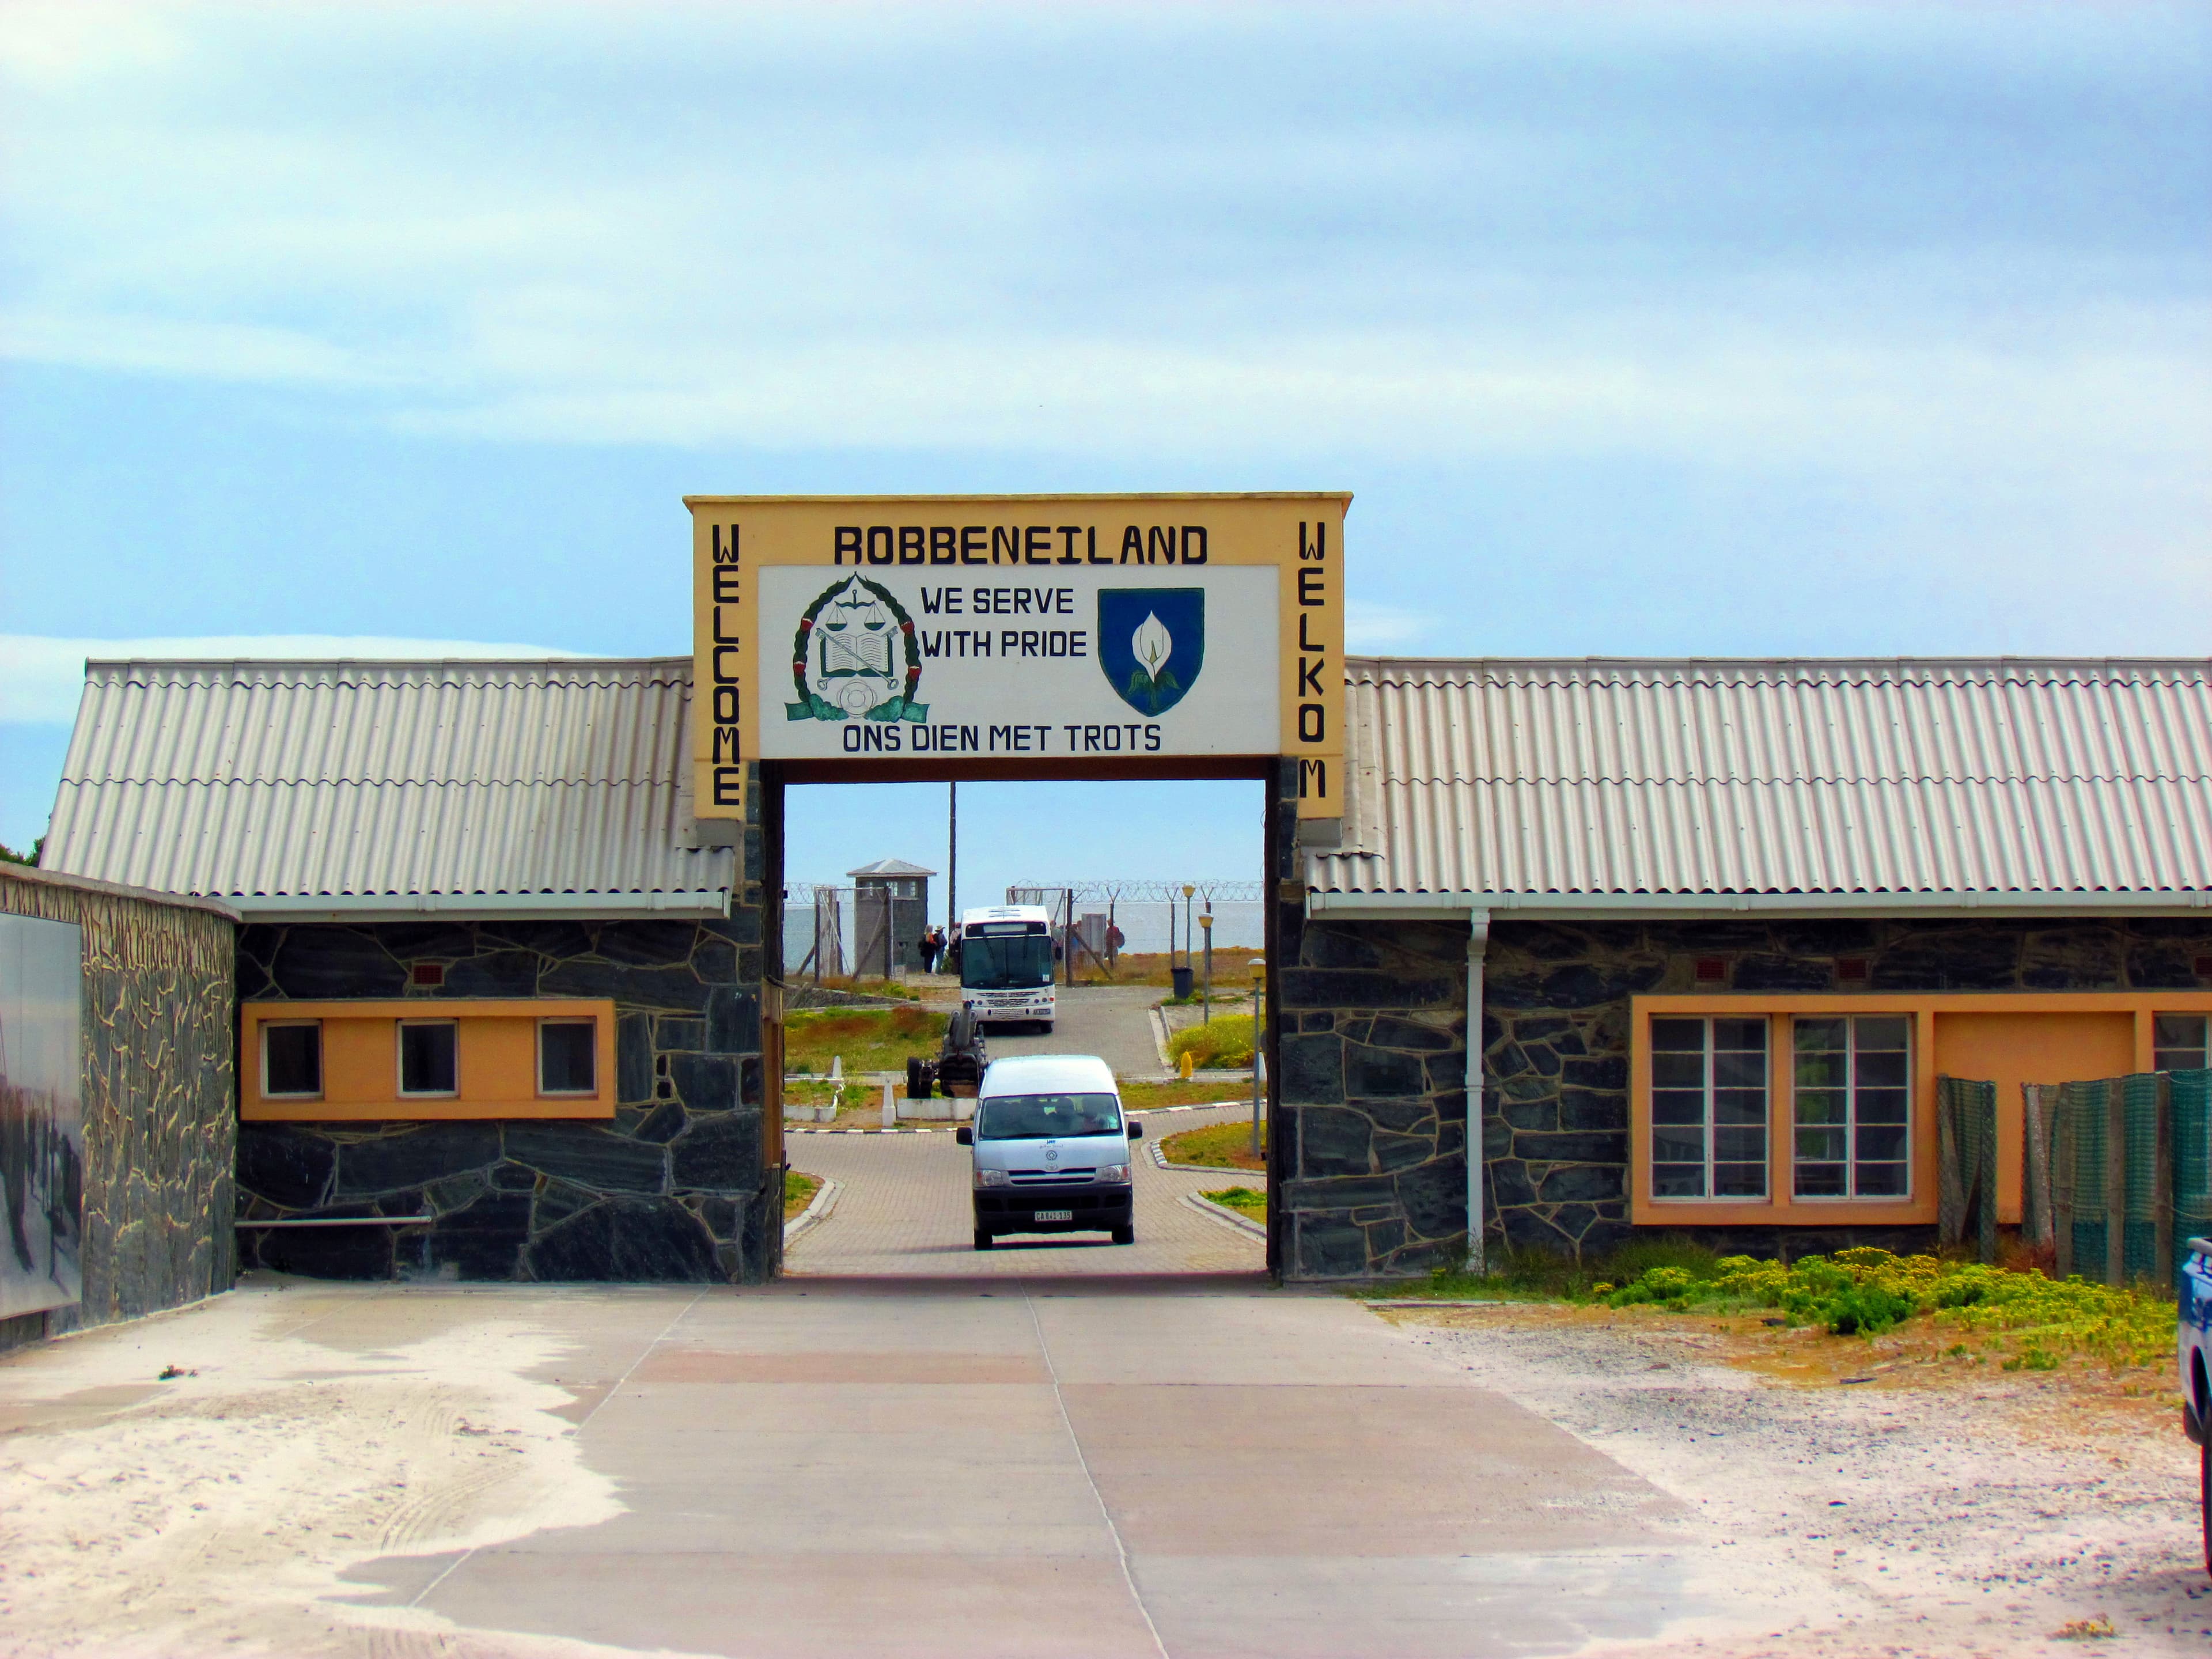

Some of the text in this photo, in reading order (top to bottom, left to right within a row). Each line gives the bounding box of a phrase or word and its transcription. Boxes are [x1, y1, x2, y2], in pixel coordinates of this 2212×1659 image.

[834, 525, 1208, 565] ROBBENEILAND
[921, 587, 1074, 614] WE SERVE
[921, 630, 1086, 657] WITH PRIDE
[1298, 521, 1325, 798] WELKOM
[711, 524, 741, 806] WELCOME
[843, 724, 1161, 752] ONS DIEN MET TROTS
